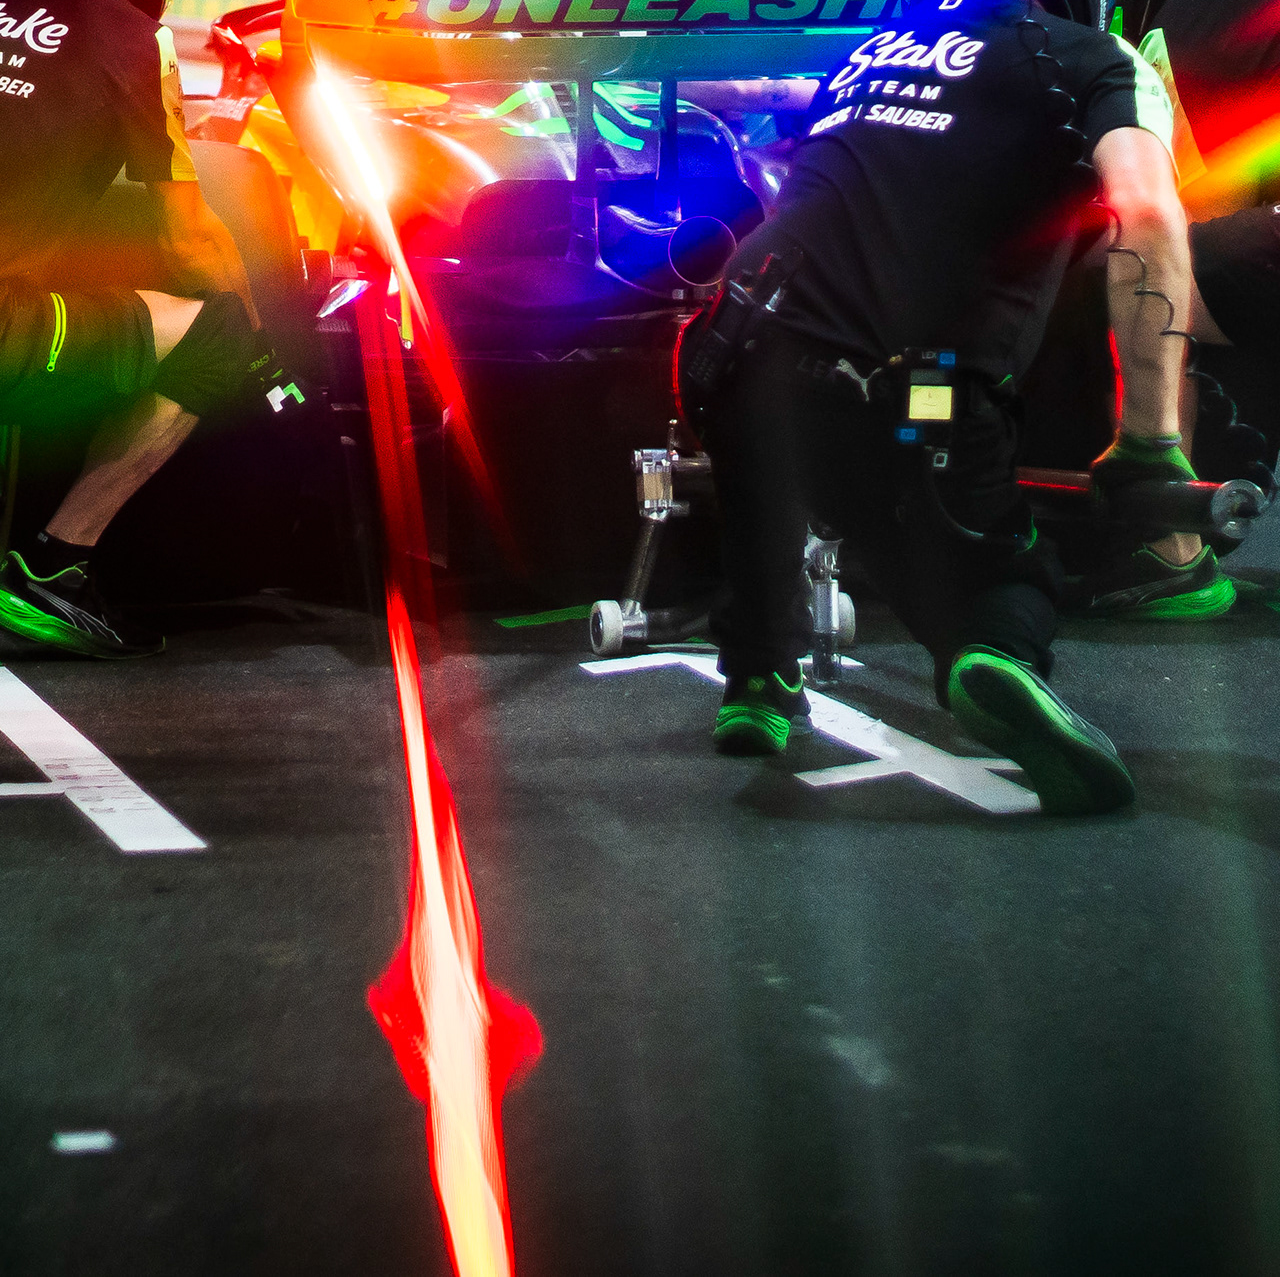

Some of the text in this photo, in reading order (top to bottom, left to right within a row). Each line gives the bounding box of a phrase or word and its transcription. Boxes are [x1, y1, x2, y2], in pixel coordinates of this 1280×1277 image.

[827, 30, 985, 91] Stake
[868, 80, 942, 100] TEAM
[864, 104, 954, 131] SAUBER
